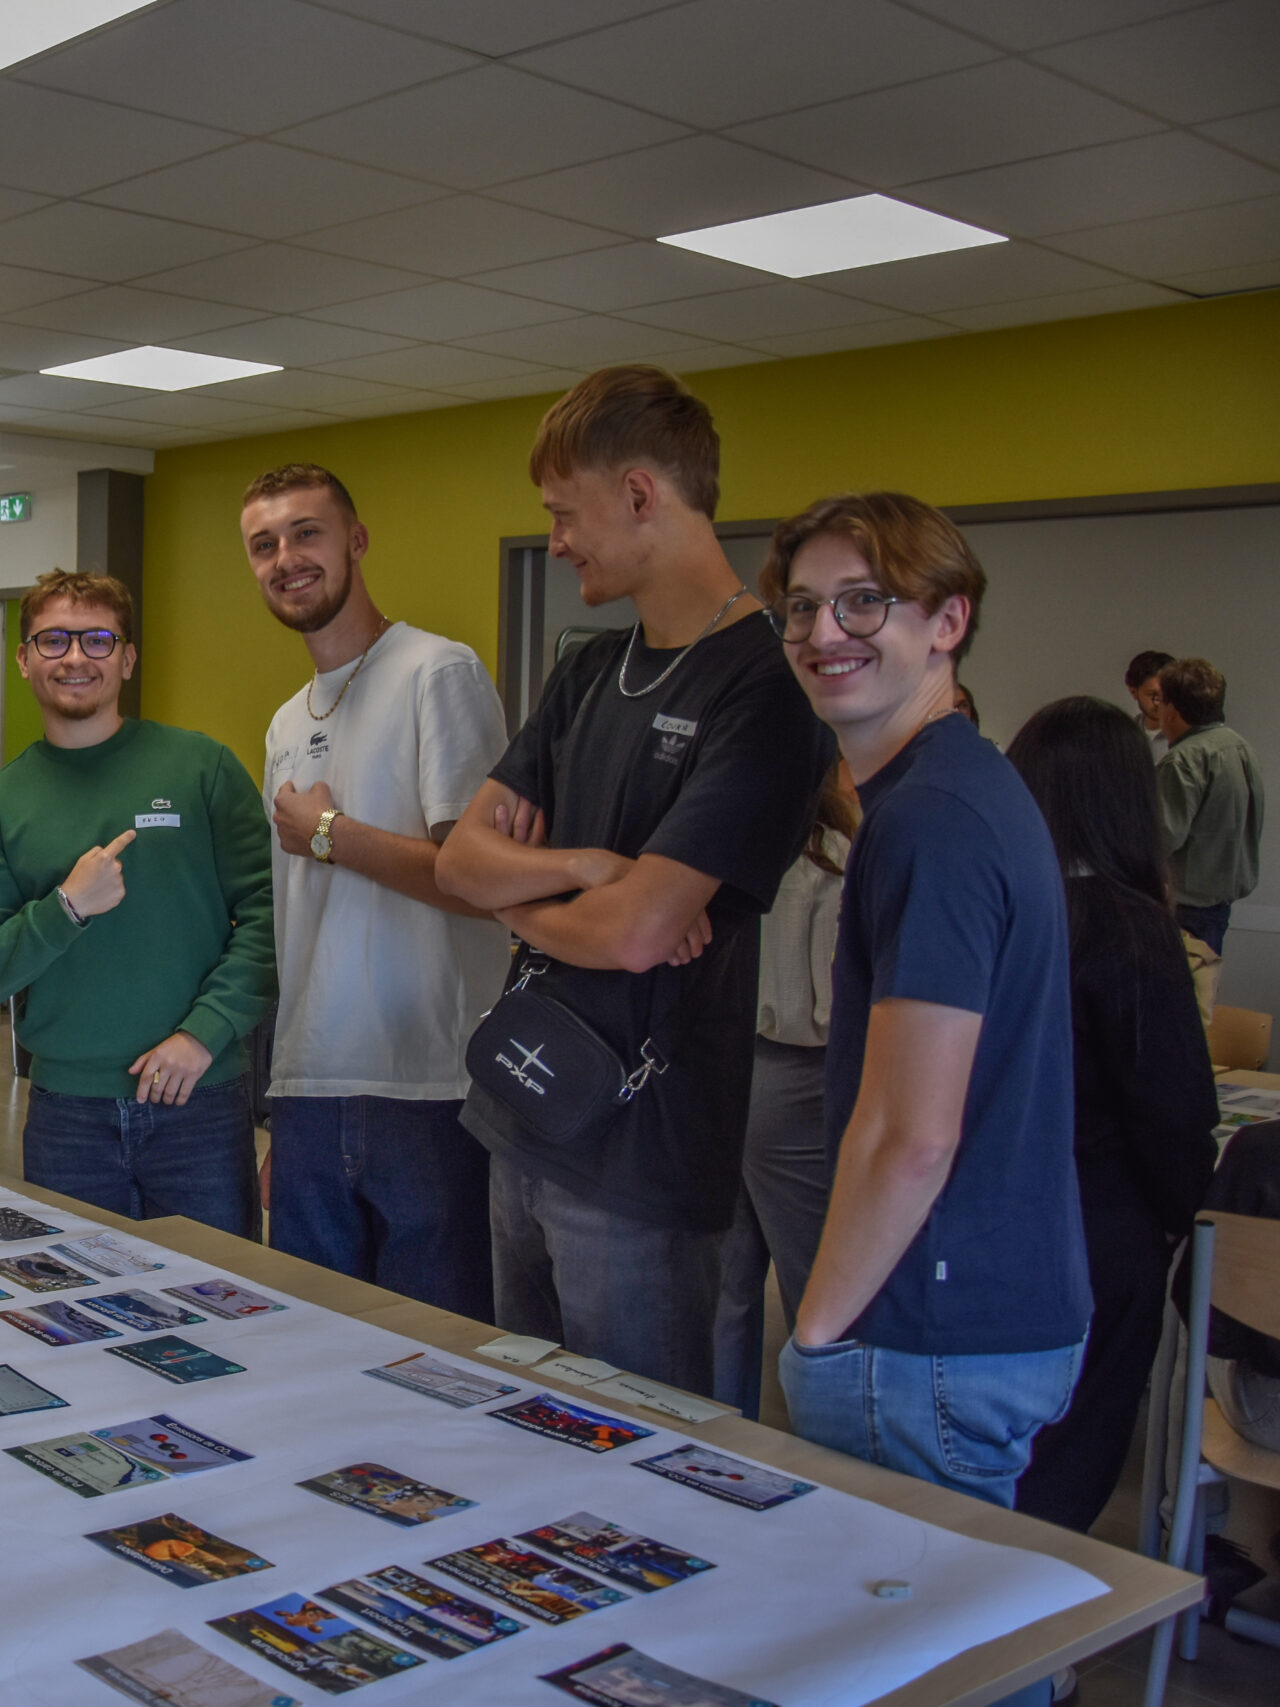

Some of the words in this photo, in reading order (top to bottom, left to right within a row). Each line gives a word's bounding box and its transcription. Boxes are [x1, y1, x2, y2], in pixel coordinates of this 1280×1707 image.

[307, 745, 329, 755] LACOSTE
[495, 1053, 545, 1094] PXP
[20, 1453, 58, 1471] carbone
[49, 1469, 68, 1477] de
[58, 1475, 86, 1487] Puits
[112, 1543, 176, 1574] Déforestation
[556, 1549, 614, 1573] Industrie
[429, 1559, 488, 1586] bâtiments
[479, 1583, 509, 1596] des
[500, 1593, 563, 1621] Utilisation
[355, 1607, 418, 1637] Transport
[246, 1636, 313, 1672] Agriculture
